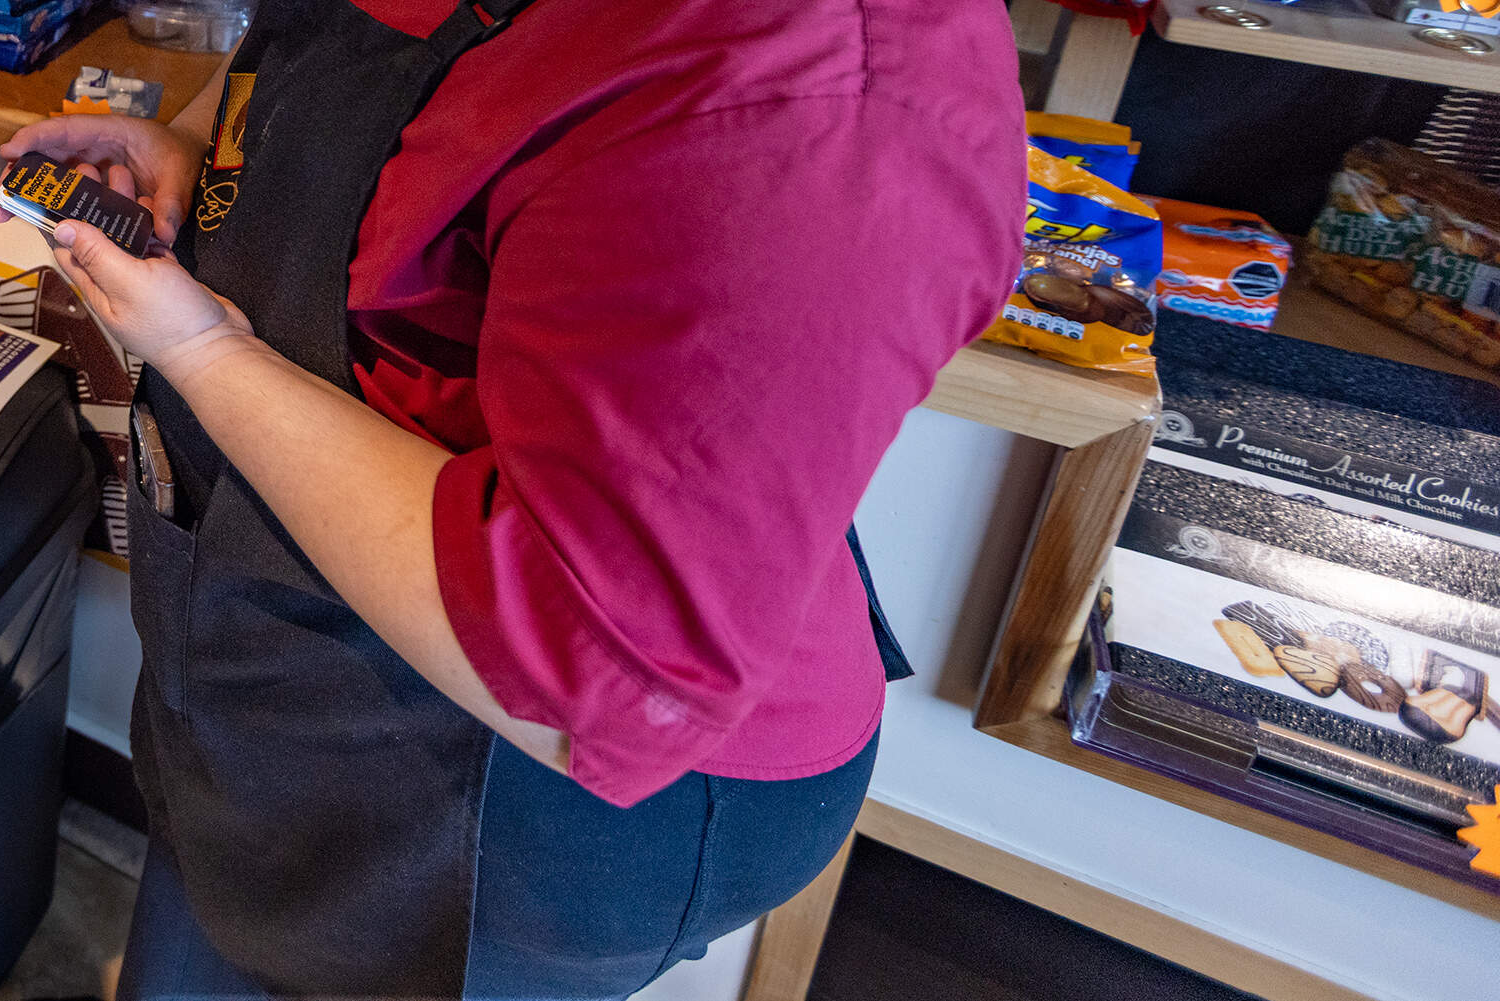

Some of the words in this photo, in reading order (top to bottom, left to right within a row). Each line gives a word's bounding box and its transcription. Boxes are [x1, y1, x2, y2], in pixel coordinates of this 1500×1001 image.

[24, 163, 52, 199] Responde
[41, 182, 55, 197] una
[1215, 425, 1309, 467] Premium
[1309, 455, 1416, 494] Assorted
[1417, 477, 1499, 517] Cookies
[1325, 477, 1351, 491] Dark
[1354, 488, 1375, 498] and
[1377, 490, 1404, 505] Milk
[1406, 498, 1463, 520] Chocolate
